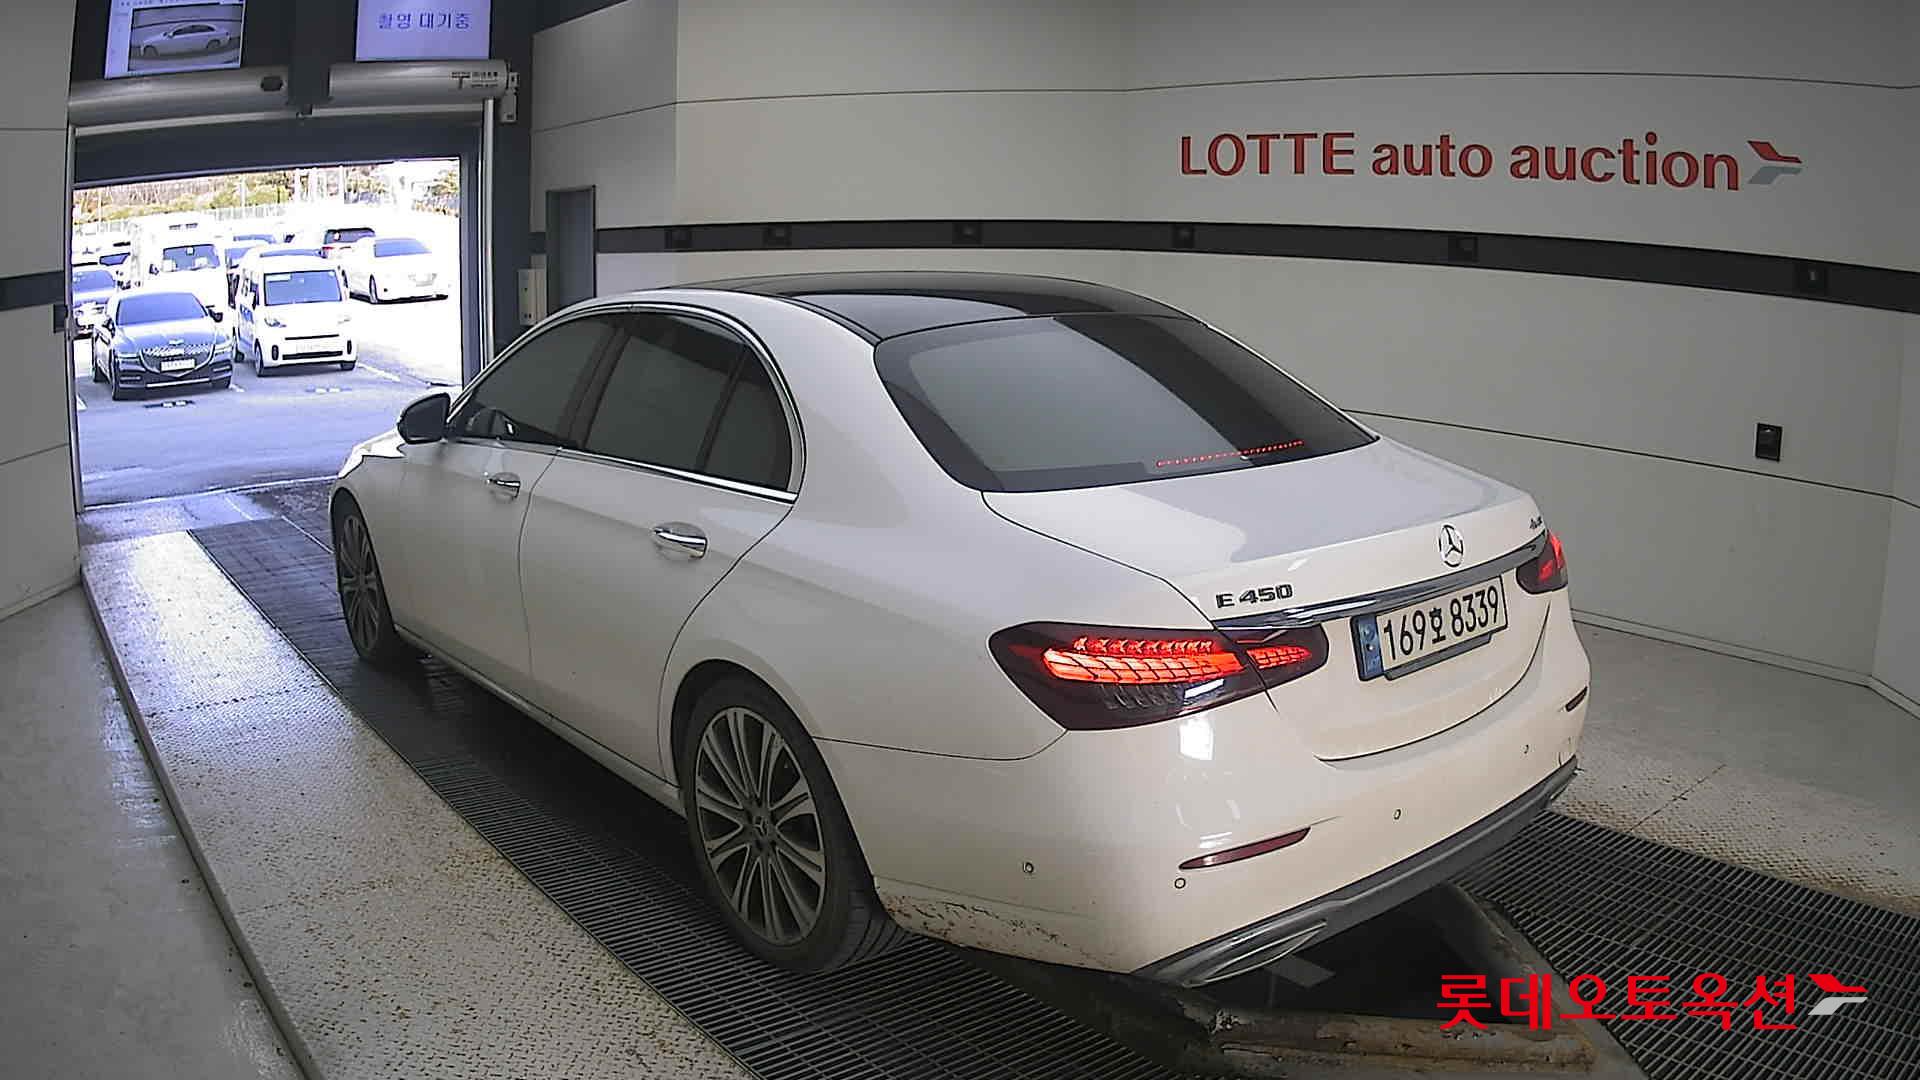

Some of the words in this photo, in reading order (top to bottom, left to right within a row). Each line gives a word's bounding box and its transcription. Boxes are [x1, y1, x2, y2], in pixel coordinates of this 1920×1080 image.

[419, 12, 470, 30] 대기중
[1180, 131, 1355, 177] LOTTE
[1372, 135, 1494, 178] auto
[1510, 132, 1740, 190] auction
[1215, 593, 1236, 609] E
[1238, 583, 1294, 604] 450
[1382, 606, 1447, 661] 169호
[1449, 585, 1499, 637] 8339
